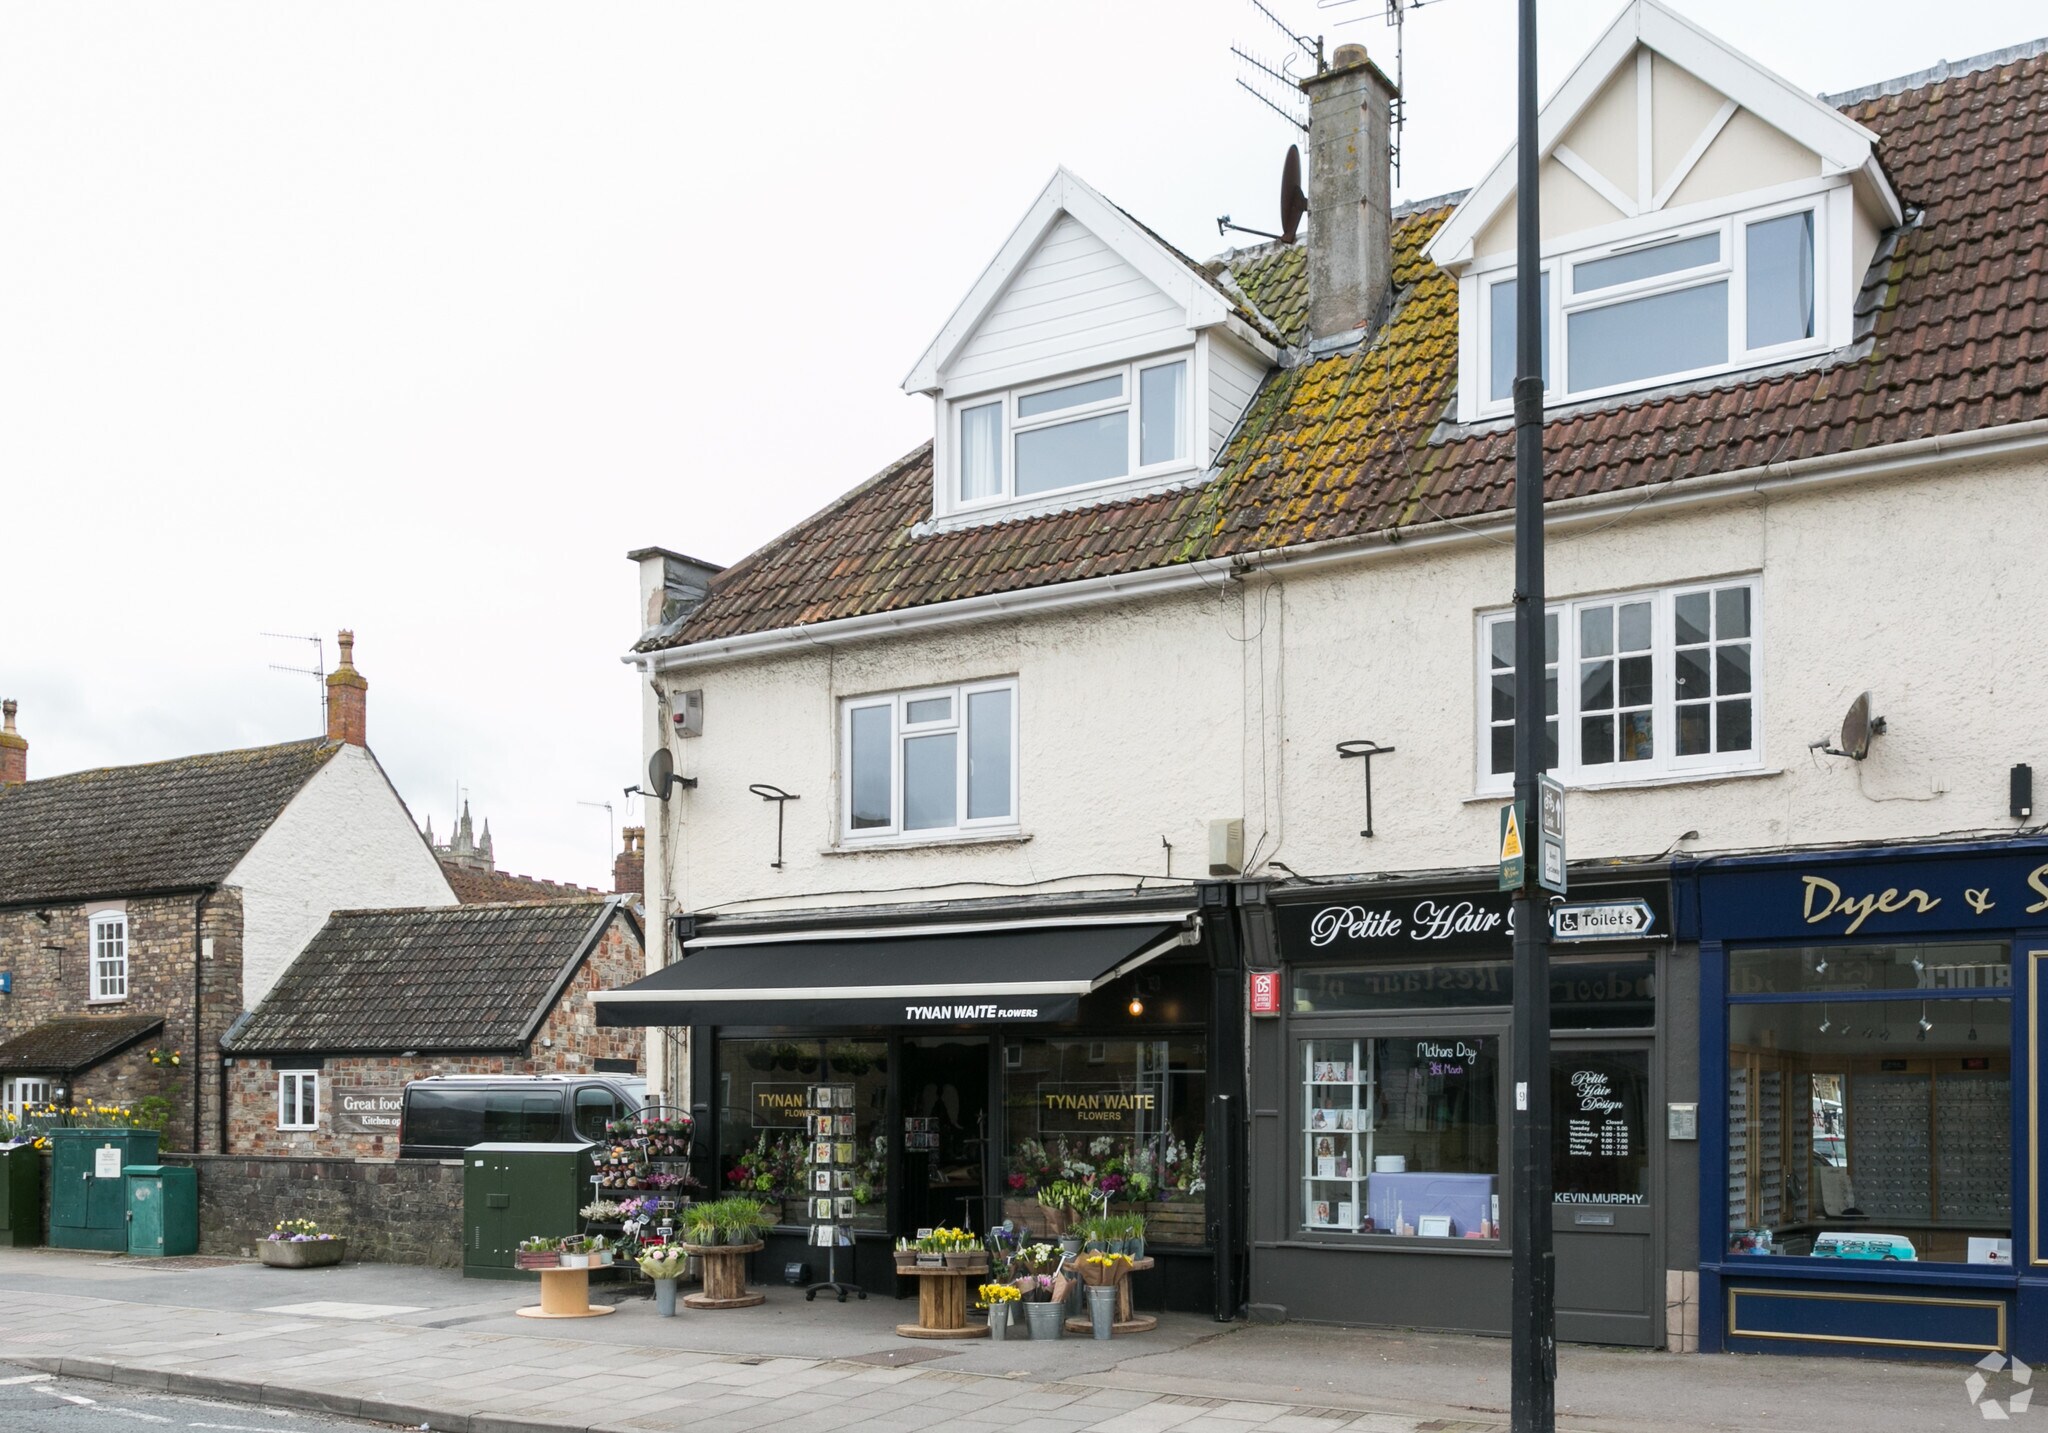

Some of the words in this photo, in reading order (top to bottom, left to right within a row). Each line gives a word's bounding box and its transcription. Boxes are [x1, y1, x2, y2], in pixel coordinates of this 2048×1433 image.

[1802, 875, 1942, 935] Dyer
[1964, 887, 1996, 915] &
[1310, 905, 1402, 947] Petite
[1410, 900, 1501, 941] Hair
[1582, 914, 1634, 927] Toilets
[905, 1006, 952, 1020] TYNAN
[953, 1005, 998, 1019] WAITE
[997, 1009, 1039, 1018] FLOWERS
[1456, 1041, 1478, 1065] Day
[1570, 1070, 1609, 1087] Petite
[1576, 1082, 1612, 1098] Hair
[343, 1096, 376, 1110] Great
[759, 1094, 803, 1107] TYNAN
[1046, 1095, 1099, 1109] TYNAN
[1103, 1095, 1155, 1109] WAITE
[1580, 1096, 1624, 1115] Design
[361, 1116, 390, 1125] Kitchen
[1077, 1111, 1122, 1120] FLOWERS
[1554, 1192, 1644, 1204] KEVIN.MURPHY
